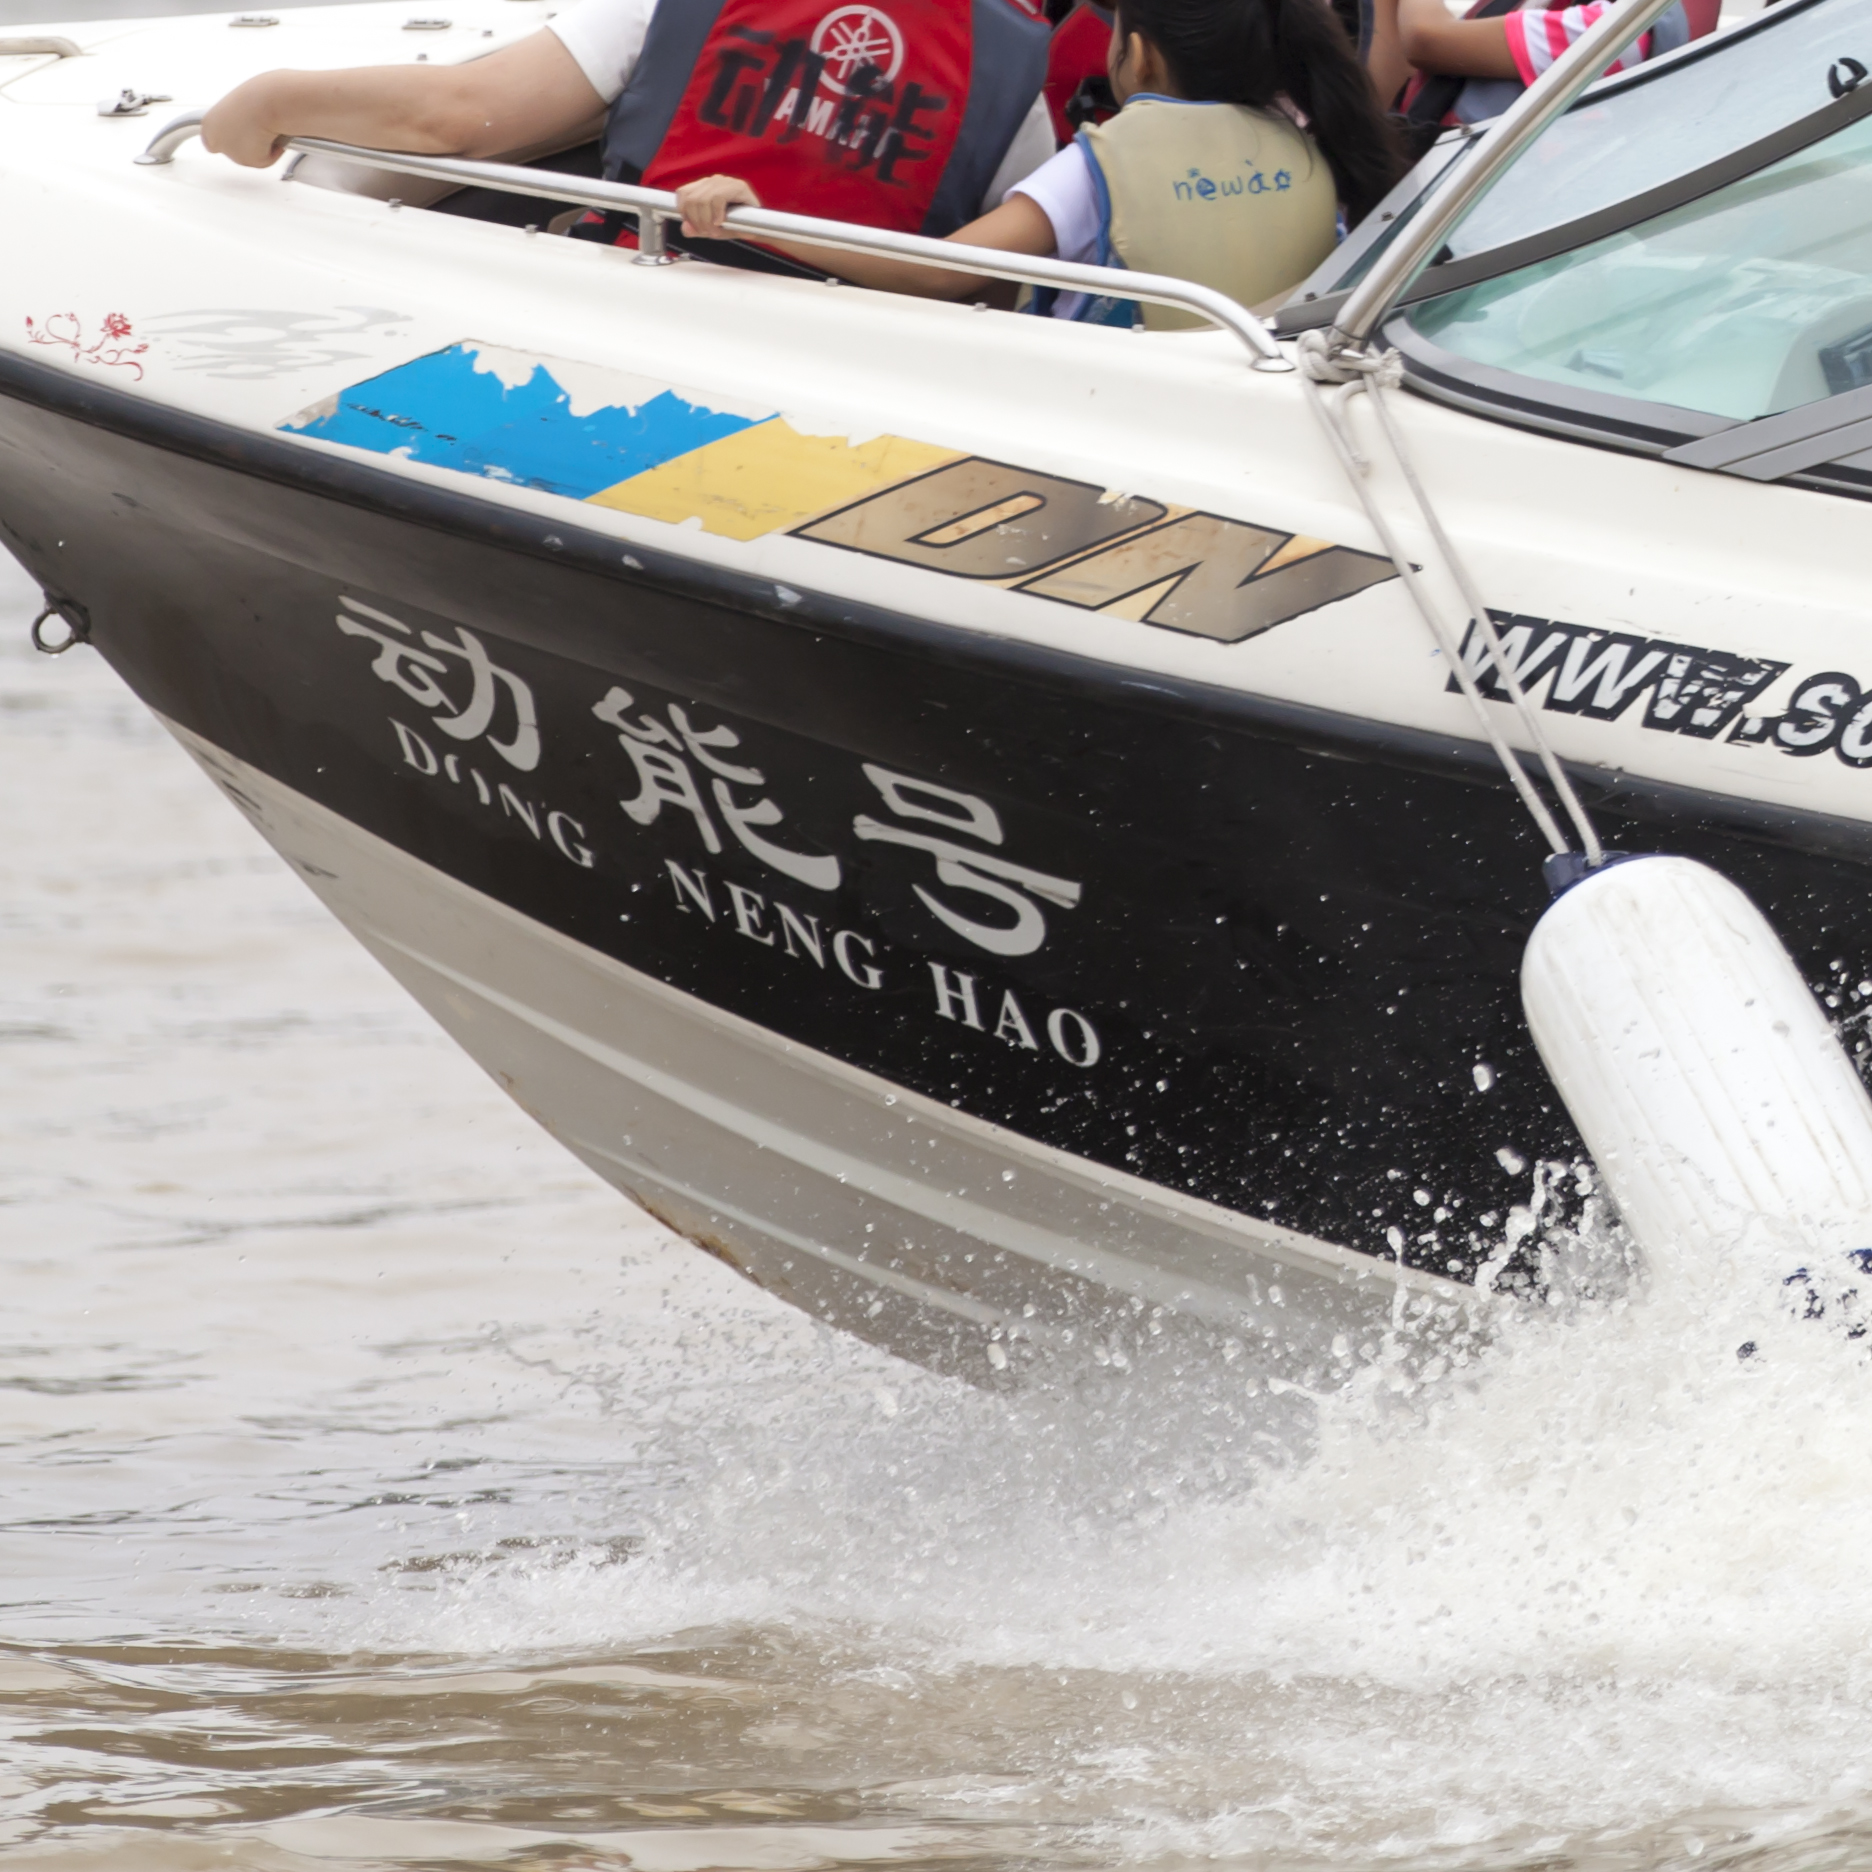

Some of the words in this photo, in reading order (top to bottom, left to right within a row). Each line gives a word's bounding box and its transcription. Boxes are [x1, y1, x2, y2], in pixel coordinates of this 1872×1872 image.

[335, 594, 1082, 957] 动能号
[387, 717, 596, 869] DONG
[664, 859, 885, 991] NENG
[926, 961, 1102, 1069] HAO
